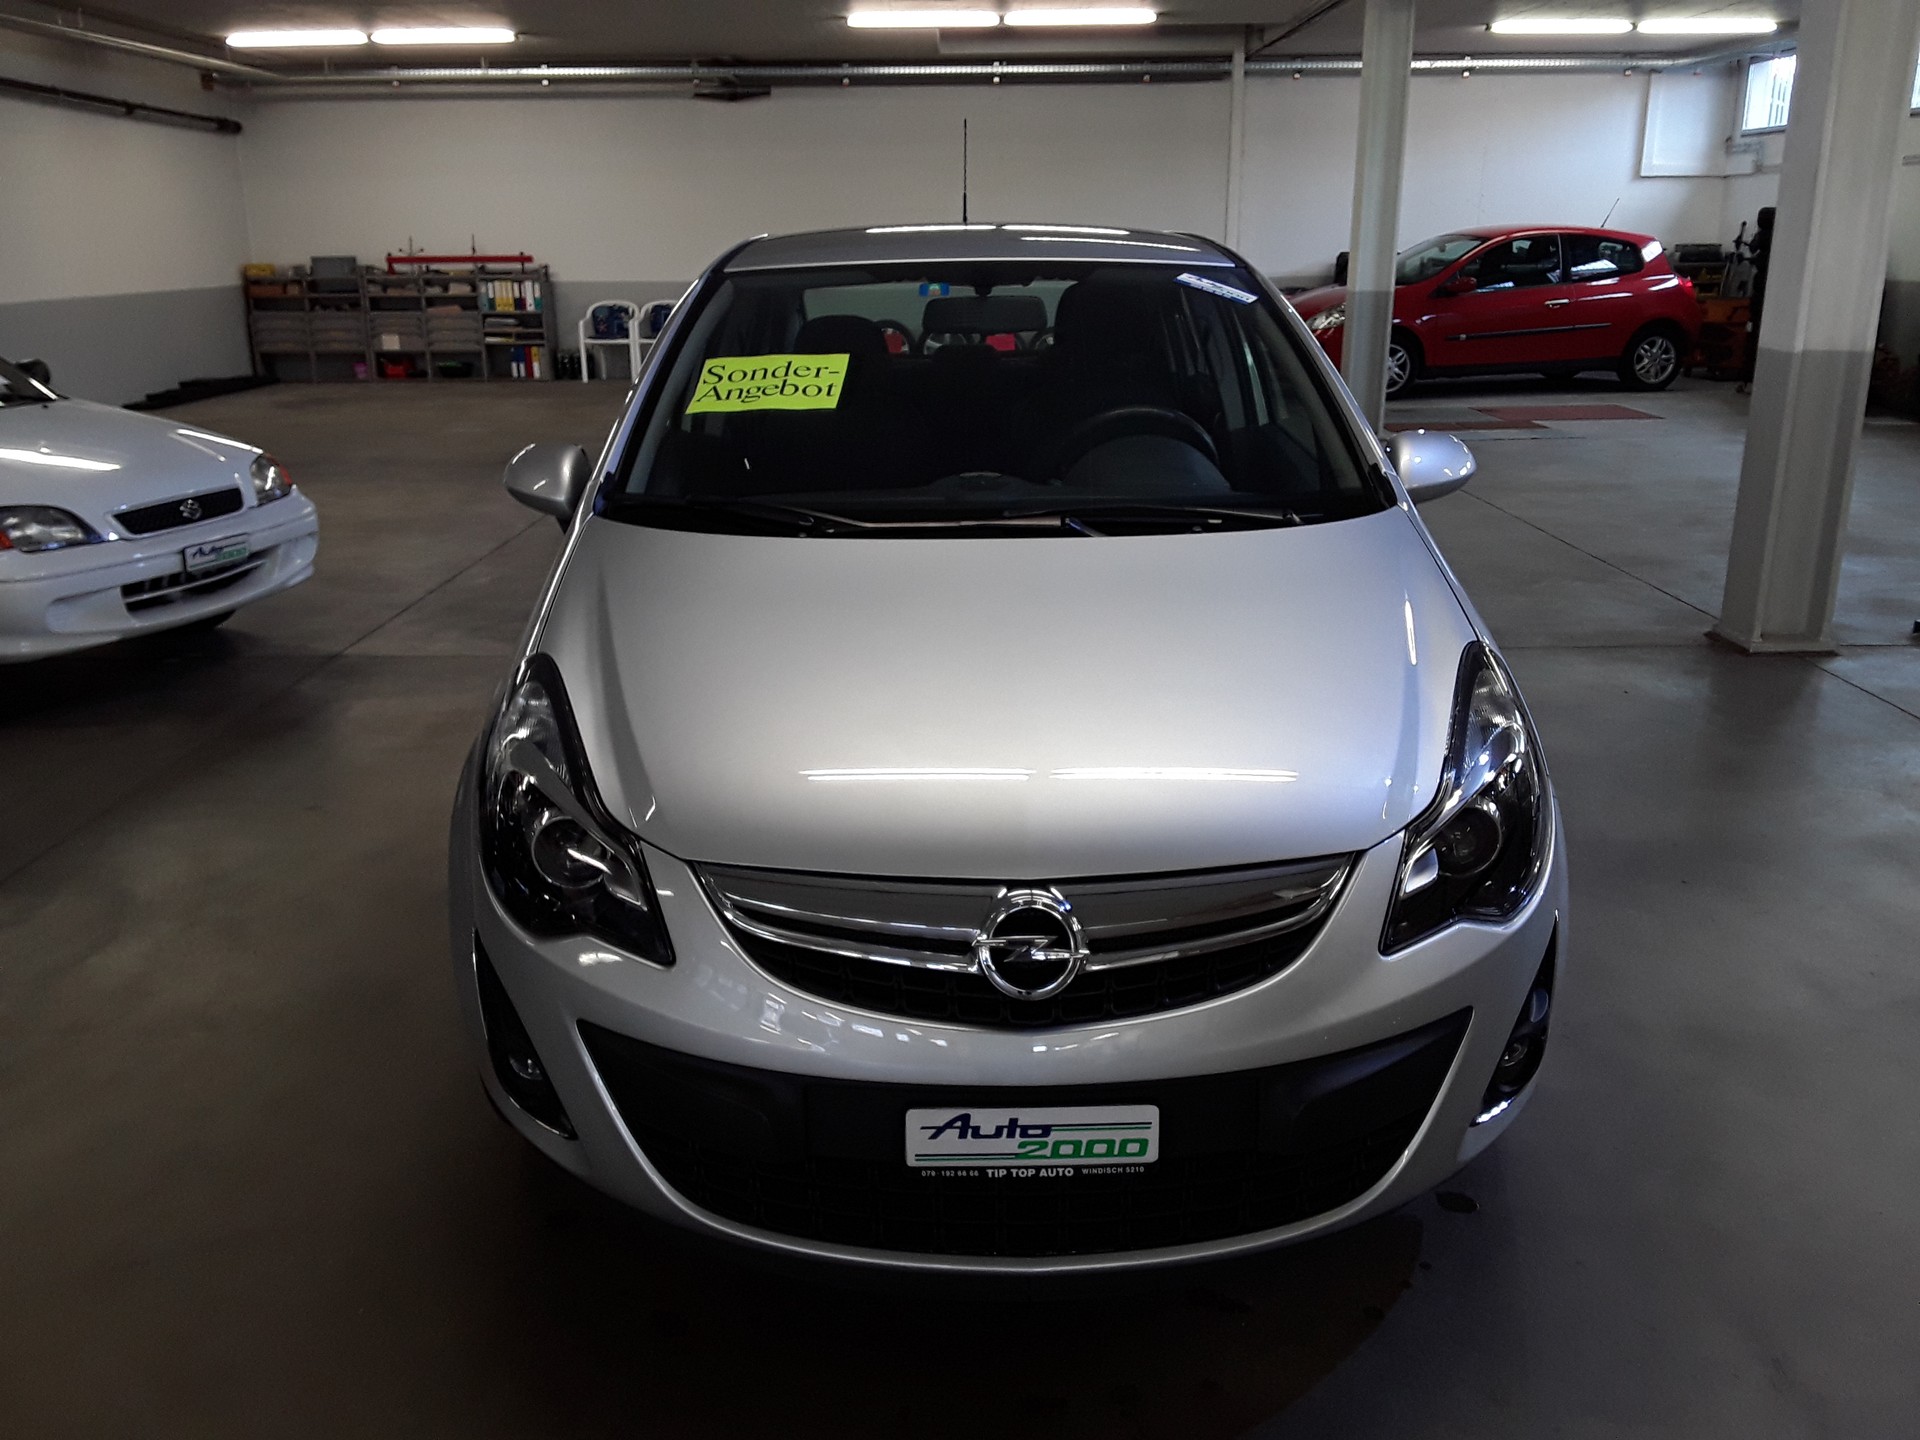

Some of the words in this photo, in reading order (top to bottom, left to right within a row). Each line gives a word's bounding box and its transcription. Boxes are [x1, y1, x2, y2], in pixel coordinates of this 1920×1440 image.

[703, 360, 840, 385] Sonder-
[696, 379, 837, 404] Angebot
[927, 1112, 1051, 1140] Auto
[1016, 1138, 1149, 1160] 2000
[986, 1168, 1007, 1178] TIP
[1010, 1168, 1036, 1178] TOP
[1039, 1167, 1074, 1177] AUTO
[1081, 1166, 1123, 1174] WINDISCH
[1125, 1165, 1145, 1173] 5210
